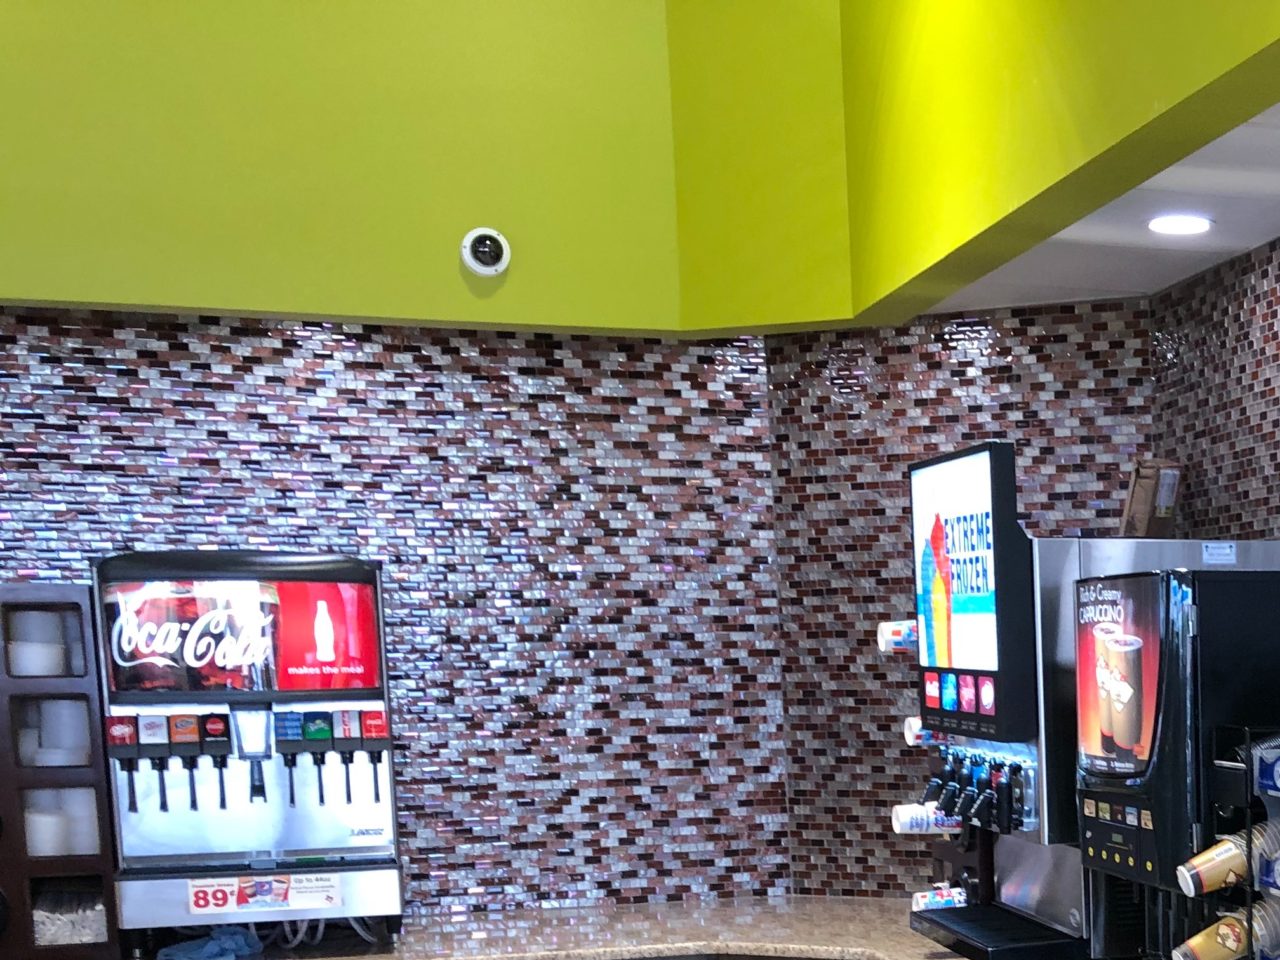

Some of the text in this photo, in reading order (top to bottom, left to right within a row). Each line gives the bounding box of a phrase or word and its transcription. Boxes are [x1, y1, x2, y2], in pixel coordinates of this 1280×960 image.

[944, 511, 991, 555] EXTREME
[949, 555, 989, 594] FROZEN
[287, 665, 364, 674] makes the meal
